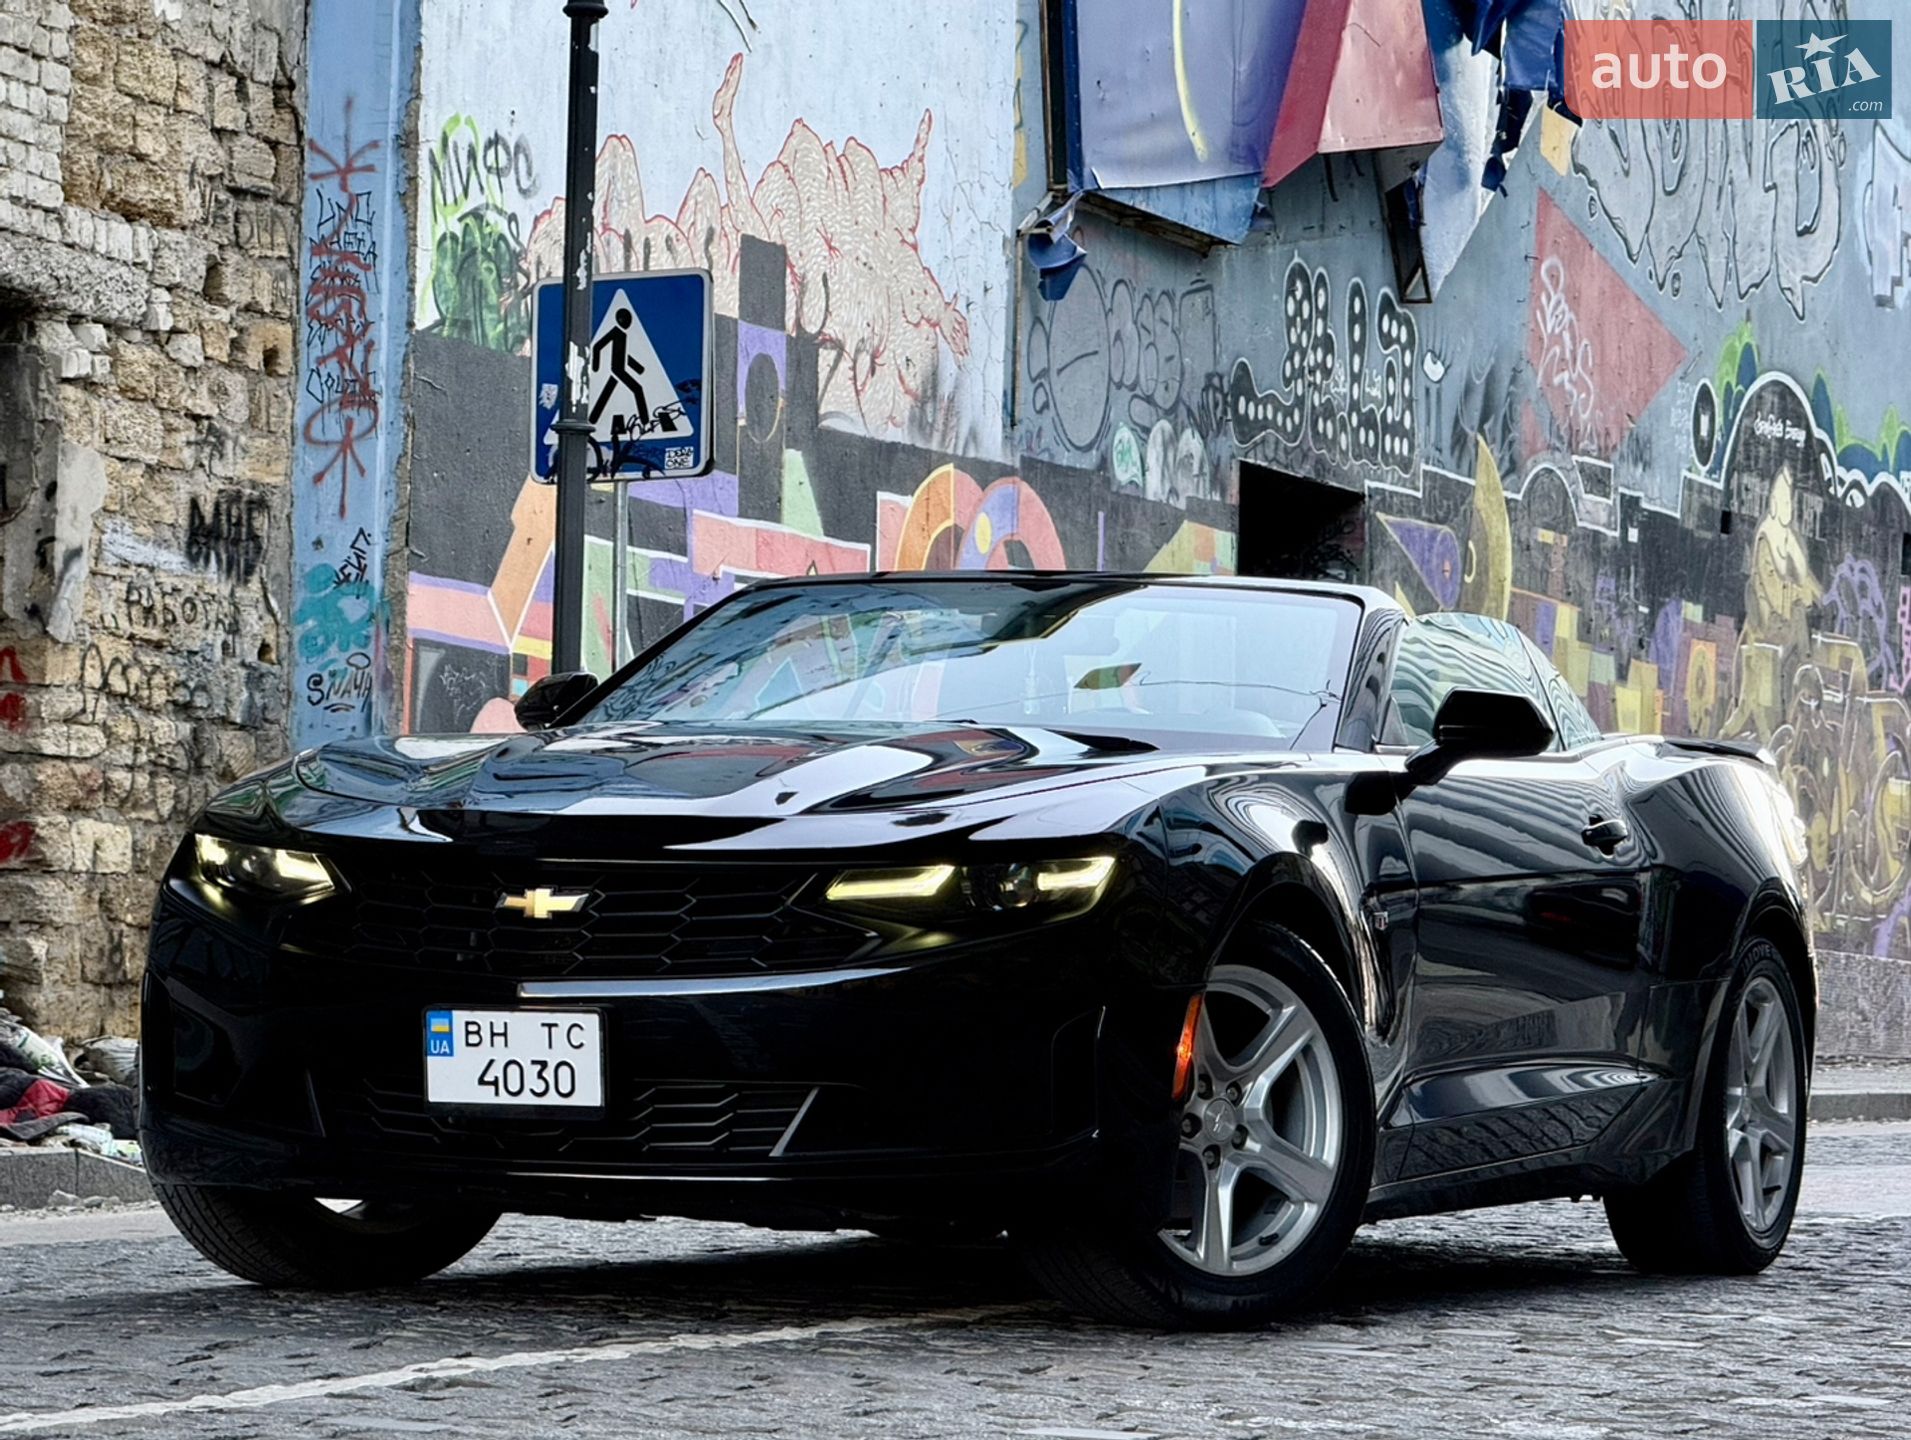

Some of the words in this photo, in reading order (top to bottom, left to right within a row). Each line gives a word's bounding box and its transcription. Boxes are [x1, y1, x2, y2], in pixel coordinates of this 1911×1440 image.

[430, 1039, 450, 1054] UA
[464, 1020, 509, 1048] BH
[541, 1022, 585, 1049] TC
[477, 1058, 576, 1099] 4030
